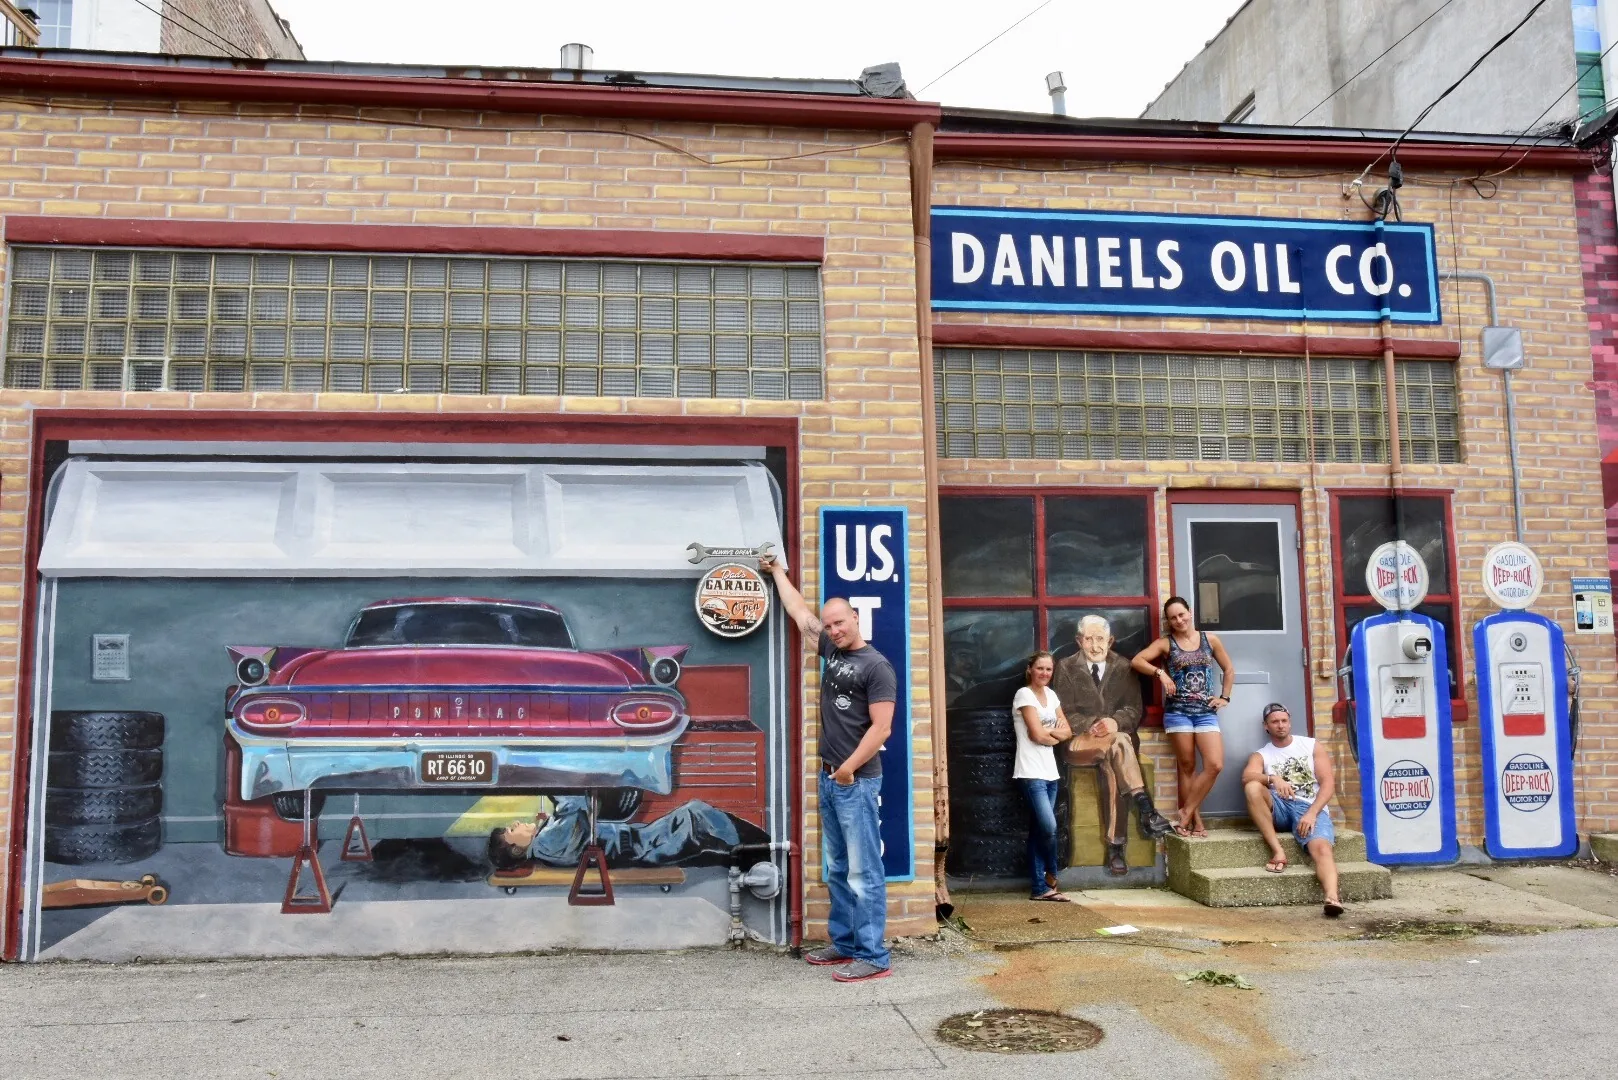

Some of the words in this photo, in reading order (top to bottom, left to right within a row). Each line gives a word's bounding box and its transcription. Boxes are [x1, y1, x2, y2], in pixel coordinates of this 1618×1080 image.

[952, 232, 1184, 289] DANIELS
[1211, 240, 1300, 294] OIL
[1325, 243, 1412, 298] CO.
[835, 524, 899, 583] U.S.
[1496, 554, 1527, 567] GASOLINE
[1493, 564, 1533, 588] DEEP-ROCK
[705, 580, 761, 591] GARAGE
[1499, 588, 1516, 597] MOTOR
[1518, 588, 1529, 597] OILS
[393, 706, 525, 720] PONTIAC
[427, 760, 446, 775] RT
[1387, 769, 1424, 777] GASOLINE
[1383, 777, 1431, 801] DEEP-ROCK
[1505, 771, 1550, 793] DEEP-ROCK
